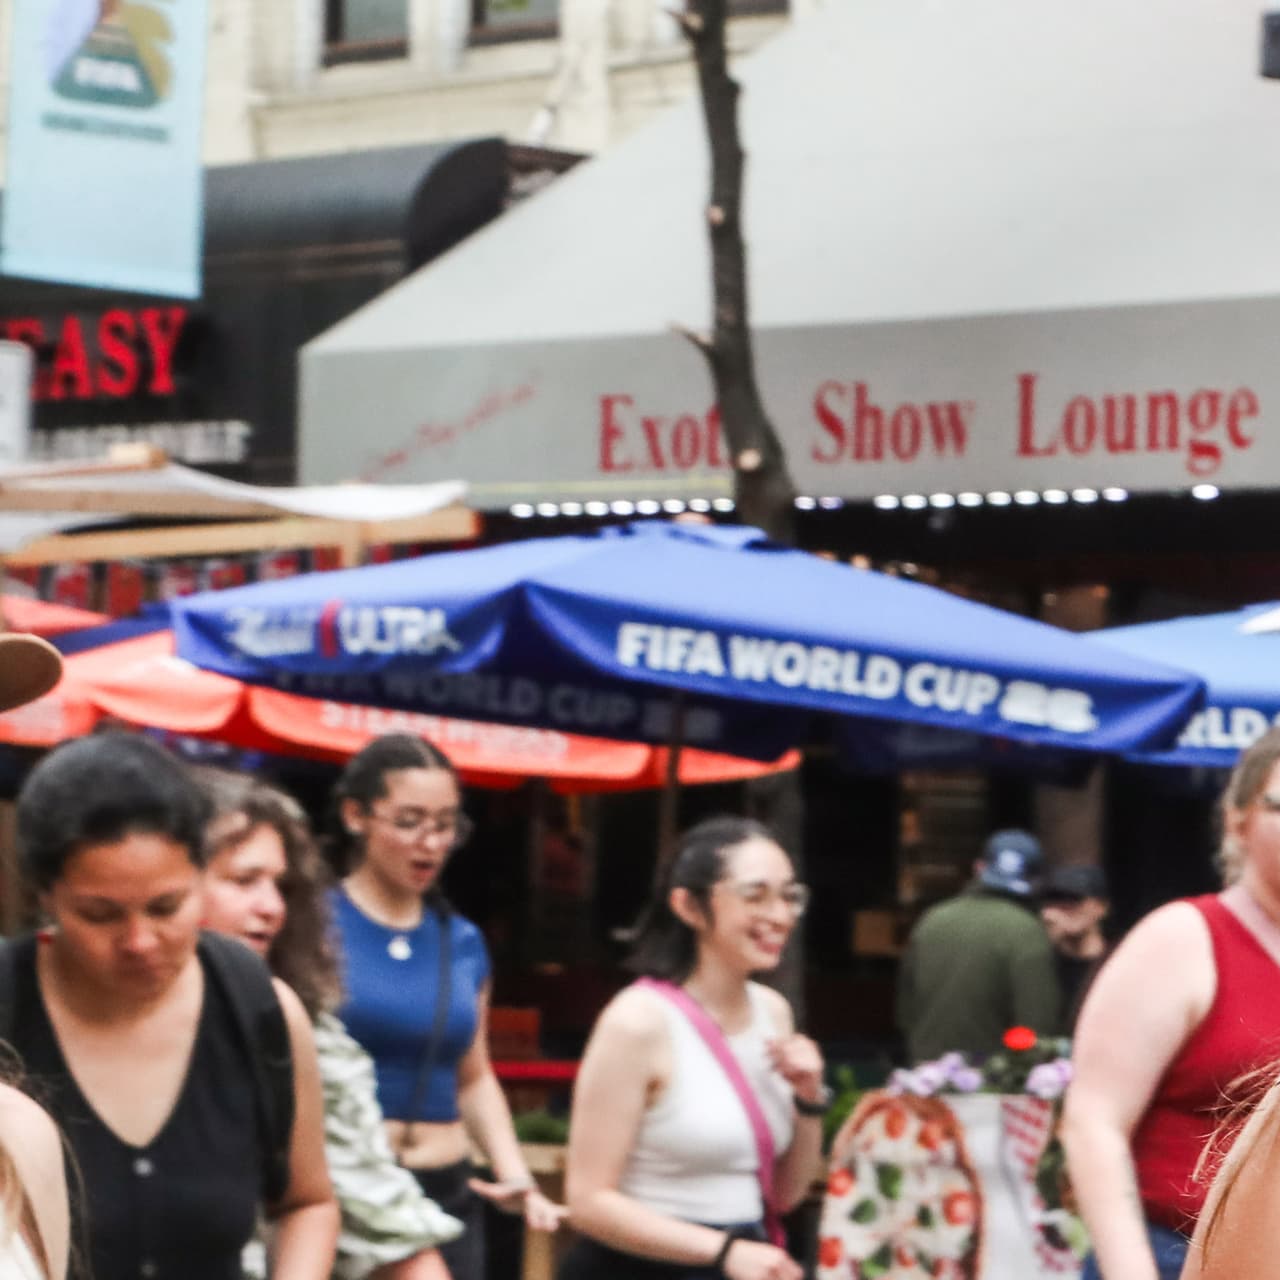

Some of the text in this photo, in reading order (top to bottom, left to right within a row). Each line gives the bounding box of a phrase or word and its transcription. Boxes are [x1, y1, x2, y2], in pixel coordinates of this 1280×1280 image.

[597, 393, 734, 472] Exot
[811, 379, 976, 465] Show
[1015, 371, 1260, 478] Lounge
[341, 605, 463, 656] ULTRA
[616, 620, 725, 677] FIFA
[729, 634, 901, 700] WORLD
[904, 661, 999, 716] CUP
